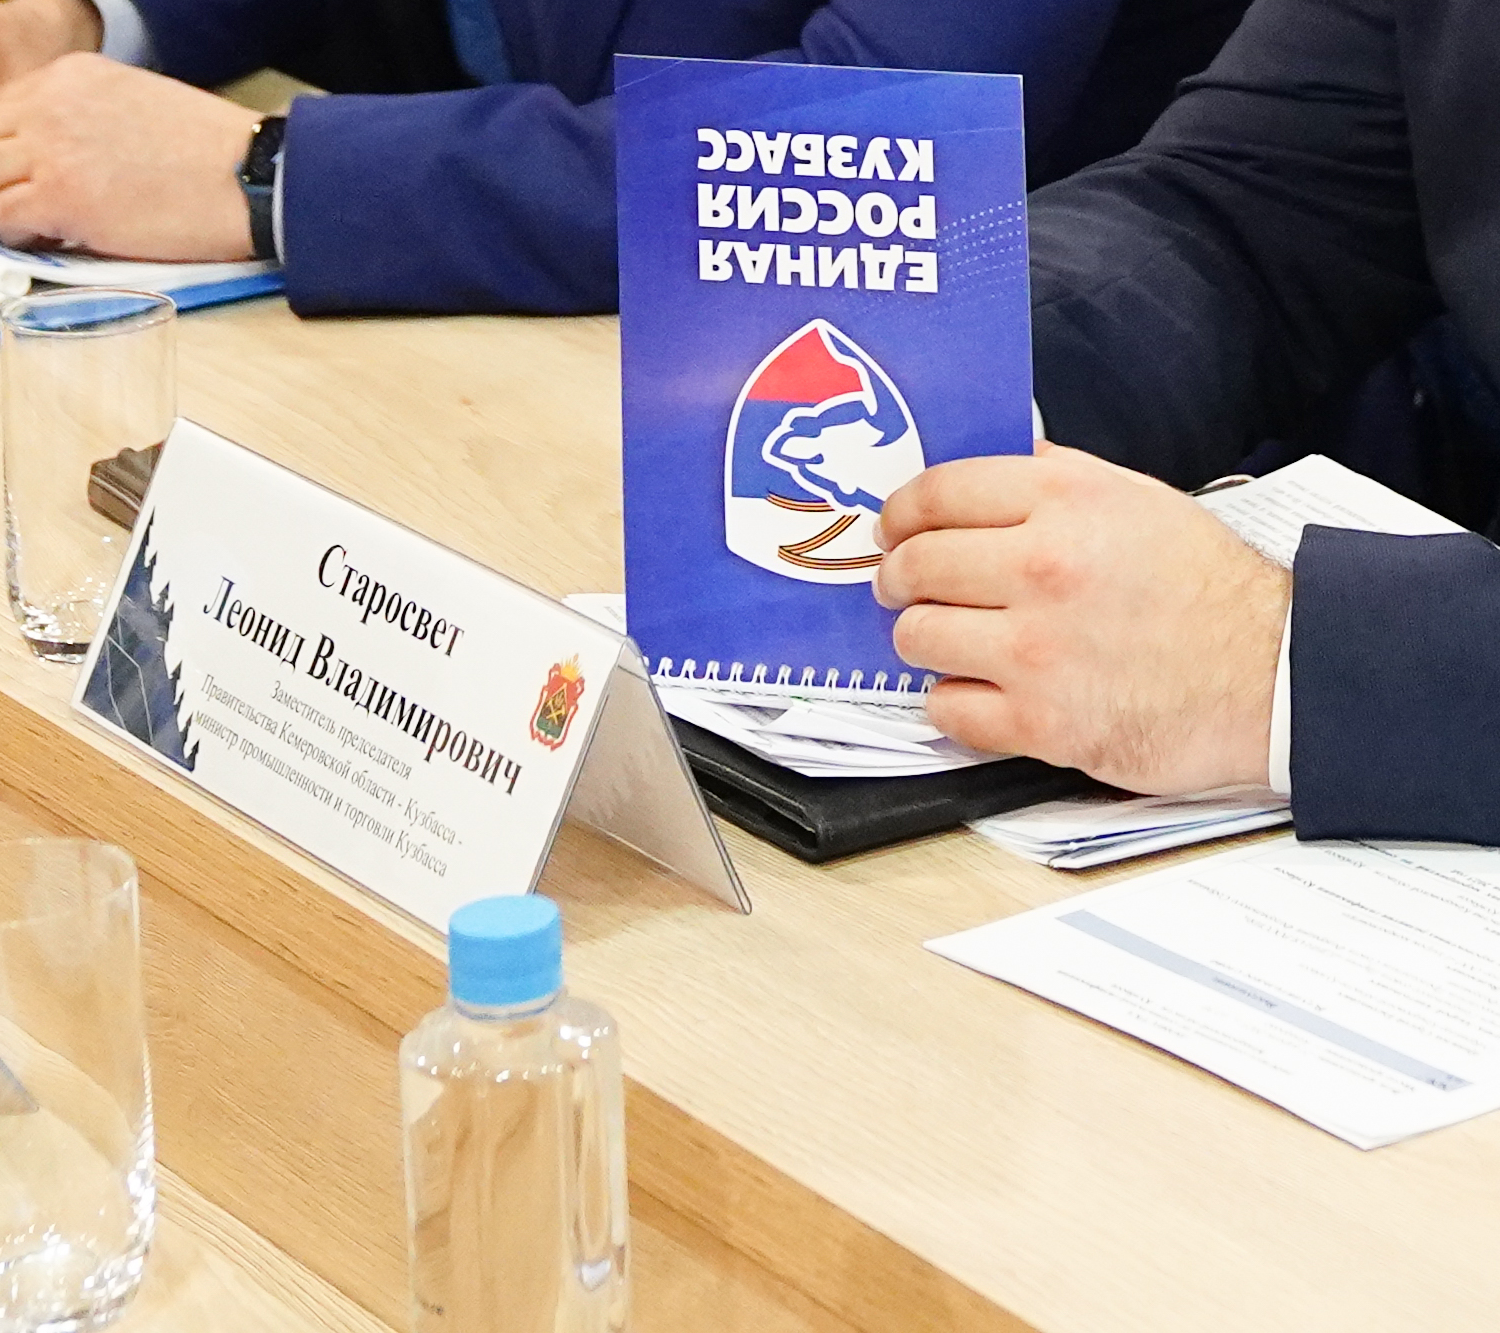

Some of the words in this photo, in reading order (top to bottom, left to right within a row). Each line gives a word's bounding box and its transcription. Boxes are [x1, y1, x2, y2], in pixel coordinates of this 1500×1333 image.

[697, 128, 935, 183] КУЗБАСС
[697, 183, 937, 240] РОССИЯ
[698, 239, 938, 293] ЕДИНАЯ
[317, 544, 465, 658] Старосвет
[202, 575, 306, 674] Леонид
[306, 632, 523, 795] Владимирович
[270, 680, 336, 735] Заместитель
[337, 724, 413, 780] председателя
[194, 709, 238, 750] министр
[238, 736, 334, 808] промышленности
[333, 794, 343, 811] и
[343, 800, 394, 845] торговли
[395, 829, 448, 877] Кузбасса
[200, 673, 278, 735] Правительства
[278, 720, 351, 779] Кемеровской
[351, 769, 396, 808] области
[403, 796, 456, 845] Кузбасса
